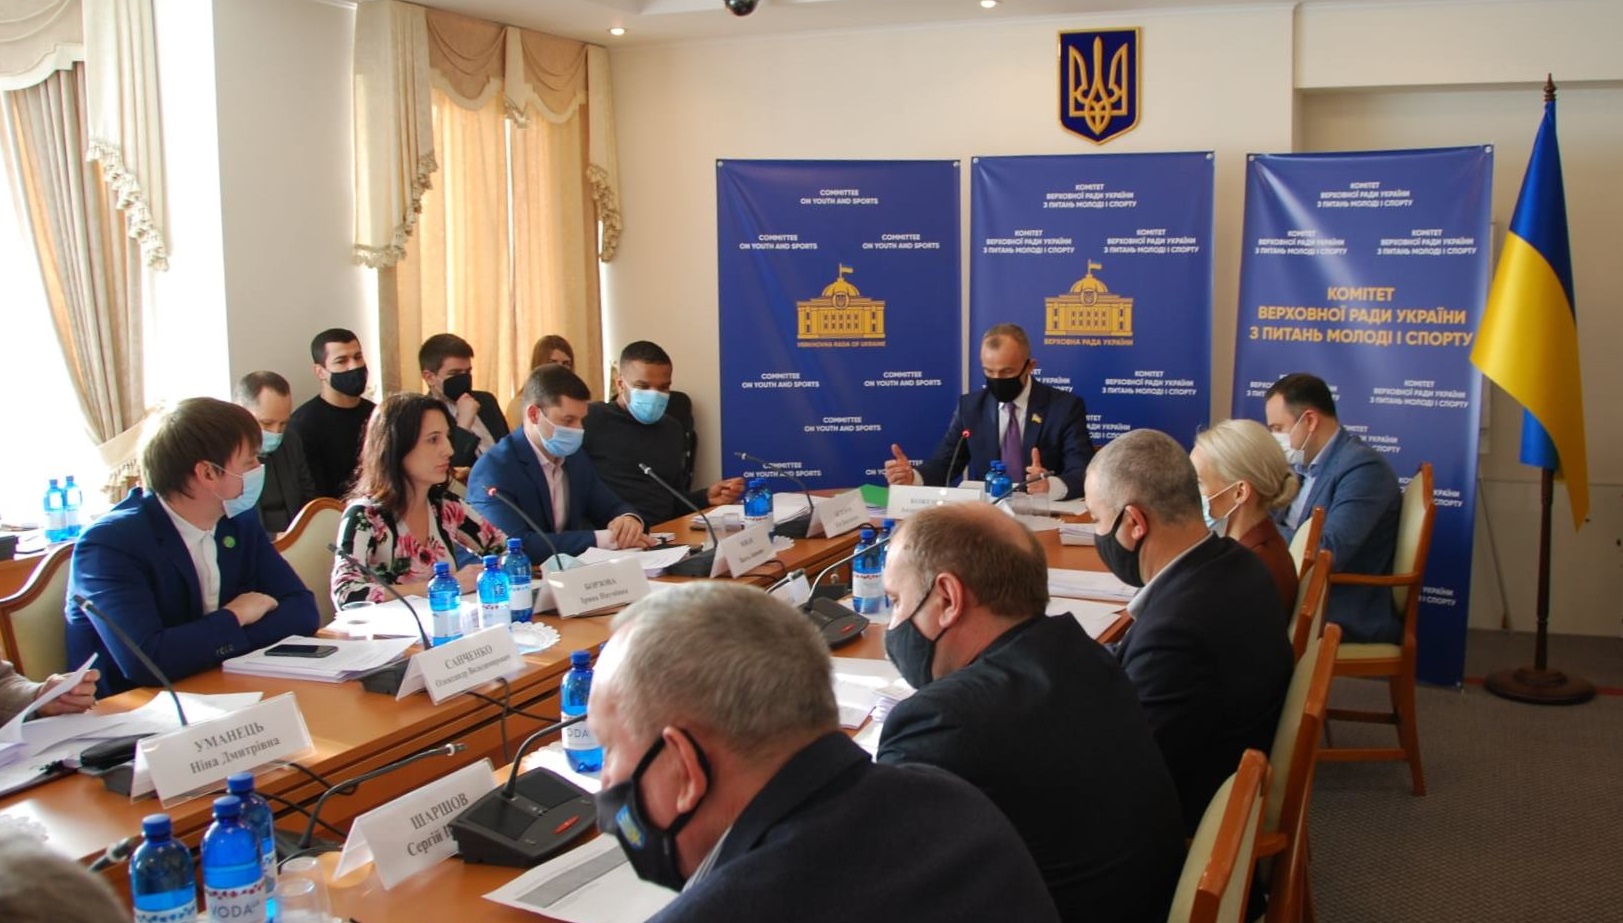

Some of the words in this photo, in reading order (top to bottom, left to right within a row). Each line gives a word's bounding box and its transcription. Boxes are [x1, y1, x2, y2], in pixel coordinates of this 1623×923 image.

[1350, 181, 1380, 189] КОМІТЕТ
[1046, 192, 1085, 200] ВЕРХОВНОЇ
[1084, 192, 1104, 200] РАДИ
[1104, 191, 1134, 199] УКРАЇНИ
[1320, 190, 1360, 199] ВЕРХОВНОЇ
[1359, 190, 1380, 199] РАДИ
[1380, 189, 1410, 198] УКРАЇНИ
[1075, 200, 1105, 209] МОЛОДІ
[1108, 200, 1137, 208] СПОРТУ
[1349, 199, 1380, 208] МОЛОДІ
[1383, 199, 1413, 207] СПОРТУ
[1287, 229, 1317, 237] КОМІТЕТ
[1411, 228, 1443, 237] КОМІТЕТ
[986, 237, 1024, 246] ВЕРХОВНОЇ
[1023, 238, 1043, 246] РАДИ
[1043, 237, 1072, 245] УКРАЇНИ
[1107, 237, 1146, 245] ВЕРХОВНОЇ
[1146, 237, 1166, 245] РАДИ
[1167, 236, 1196, 245] УКРАЇНИ
[1258, 238, 1296, 246] ВЕРХОВНОЇ
[1297, 238, 1316, 247] РАДИ
[1316, 238, 1345, 246] УКРАЇНИ
[1380, 237, 1421, 246] ВЕРХОВНОЇ
[1421, 238, 1442, 247] РАДИ
[1442, 237, 1474, 245] УКРАЇНИ
[1015, 246, 1043, 254] МОЛОДІ
[1136, 246, 1167, 254] МОЛОДІ
[1170, 245, 1199, 254] СПОРТУ
[1259, 246, 1287, 255] ПИТАНЬ
[1319, 247, 1348, 256] СПОРТУ
[1382, 247, 1411, 255] ПИТАНЬ
[1411, 247, 1442, 256] МОЛОДІ
[1446, 247, 1476, 255] СПОРТУ
[1328, 286, 1396, 301] КОМІТЕТ
[1258, 305, 1345, 322] ВЕРХОВНОЇ
[1350, 307, 1392, 324] РАДИ
[1397, 307, 1466, 324] УКРАЇНИ
[1263, 326, 1323, 342] ПИТАНЬ
[1326, 329, 1393, 347] МОЛОДІ
[1405, 331, 1473, 347] СПОРТУ
[1105, 378, 1144, 386] ВЕРХОВНОЇ
[1144, 379, 1164, 387] РАДИ
[1164, 379, 1194, 387] УКРАЇНИ
[1404, 380, 1435, 388] КОМІТЕТ
[1107, 386, 1135, 395] ПИТАНЬ
[1134, 387, 1164, 396] МОЛОДІ
[1373, 387, 1414, 396] ВЕРХОВНОЇ
[1414, 388, 1434, 398] РАДИ
[1435, 390, 1466, 399] УКРАЇНИ
[1375, 396, 1403, 405] ПИТАНЬ
[1404, 398, 1434, 408] МОЛОДІ
[1439, 400, 1469, 408] СПОРТУ
[743, 470, 755, 479] ON
[445, 644, 492, 670] САНЧЕНКО
[194, 722, 264, 752] УМАНЕЦЬ
[190, 758, 219, 774] Ніна
[221, 737, 280, 765] Дмитрівна
[410, 793, 468, 830] ШАРШОВ
[407, 829, 444, 856] Сергій
